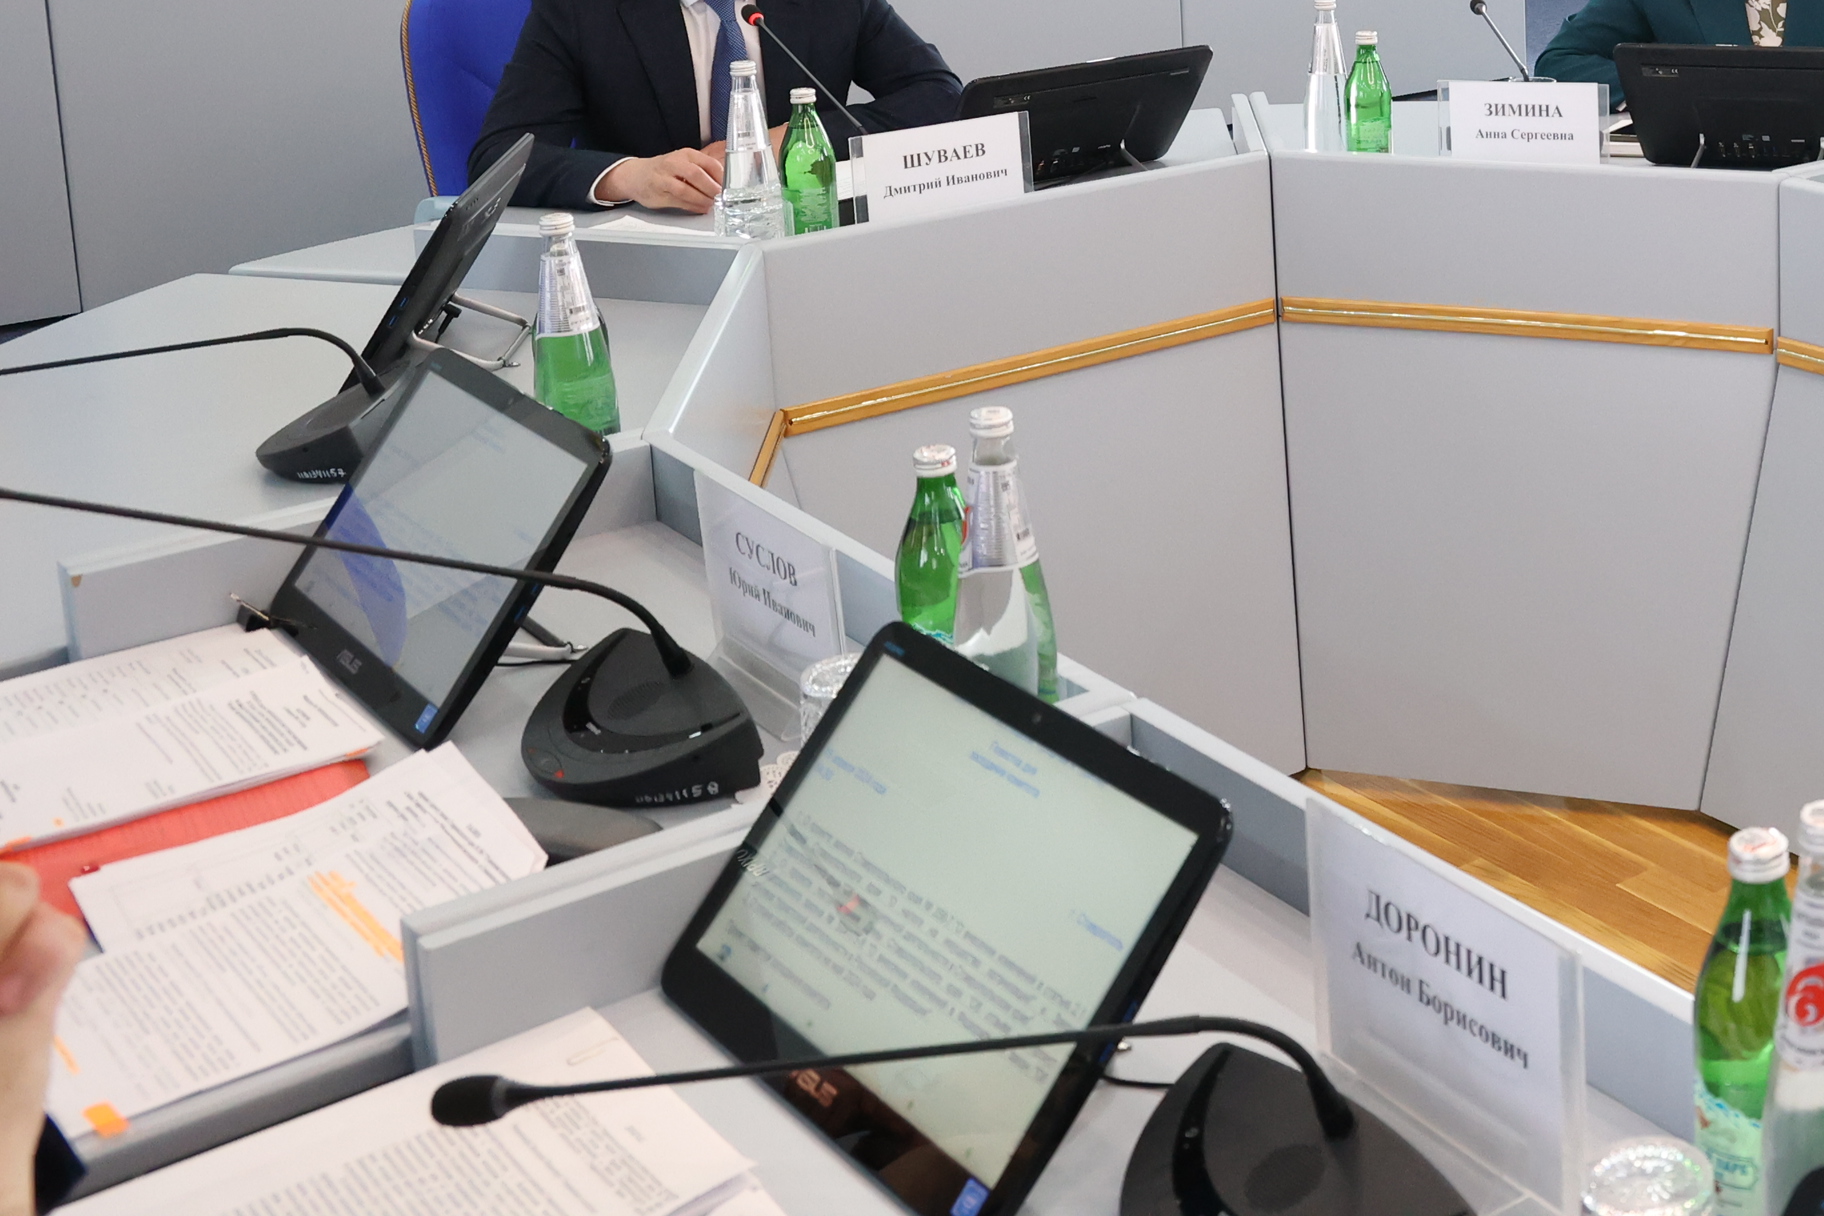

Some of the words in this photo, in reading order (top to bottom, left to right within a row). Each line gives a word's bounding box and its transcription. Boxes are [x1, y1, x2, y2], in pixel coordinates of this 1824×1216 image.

[1484, 103, 1564, 119] ЗИМИНА
[903, 142, 986, 170] ШУВАЕВ
[1475, 127, 1508, 142] Анна
[1511, 129, 1575, 144] Сергеевна
[882, 177, 942, 199] Дмитрий
[944, 167, 1008, 188] Иванович
[734, 531, 798, 587] СУСЛОВ
[728, 566, 764, 599] Юрий
[764, 584, 816, 638] Иванович
[1364, 889, 1509, 1000] ДОРОНИН
[1352, 940, 1413, 998] Антон
[1417, 974, 1530, 1070] Борисович
